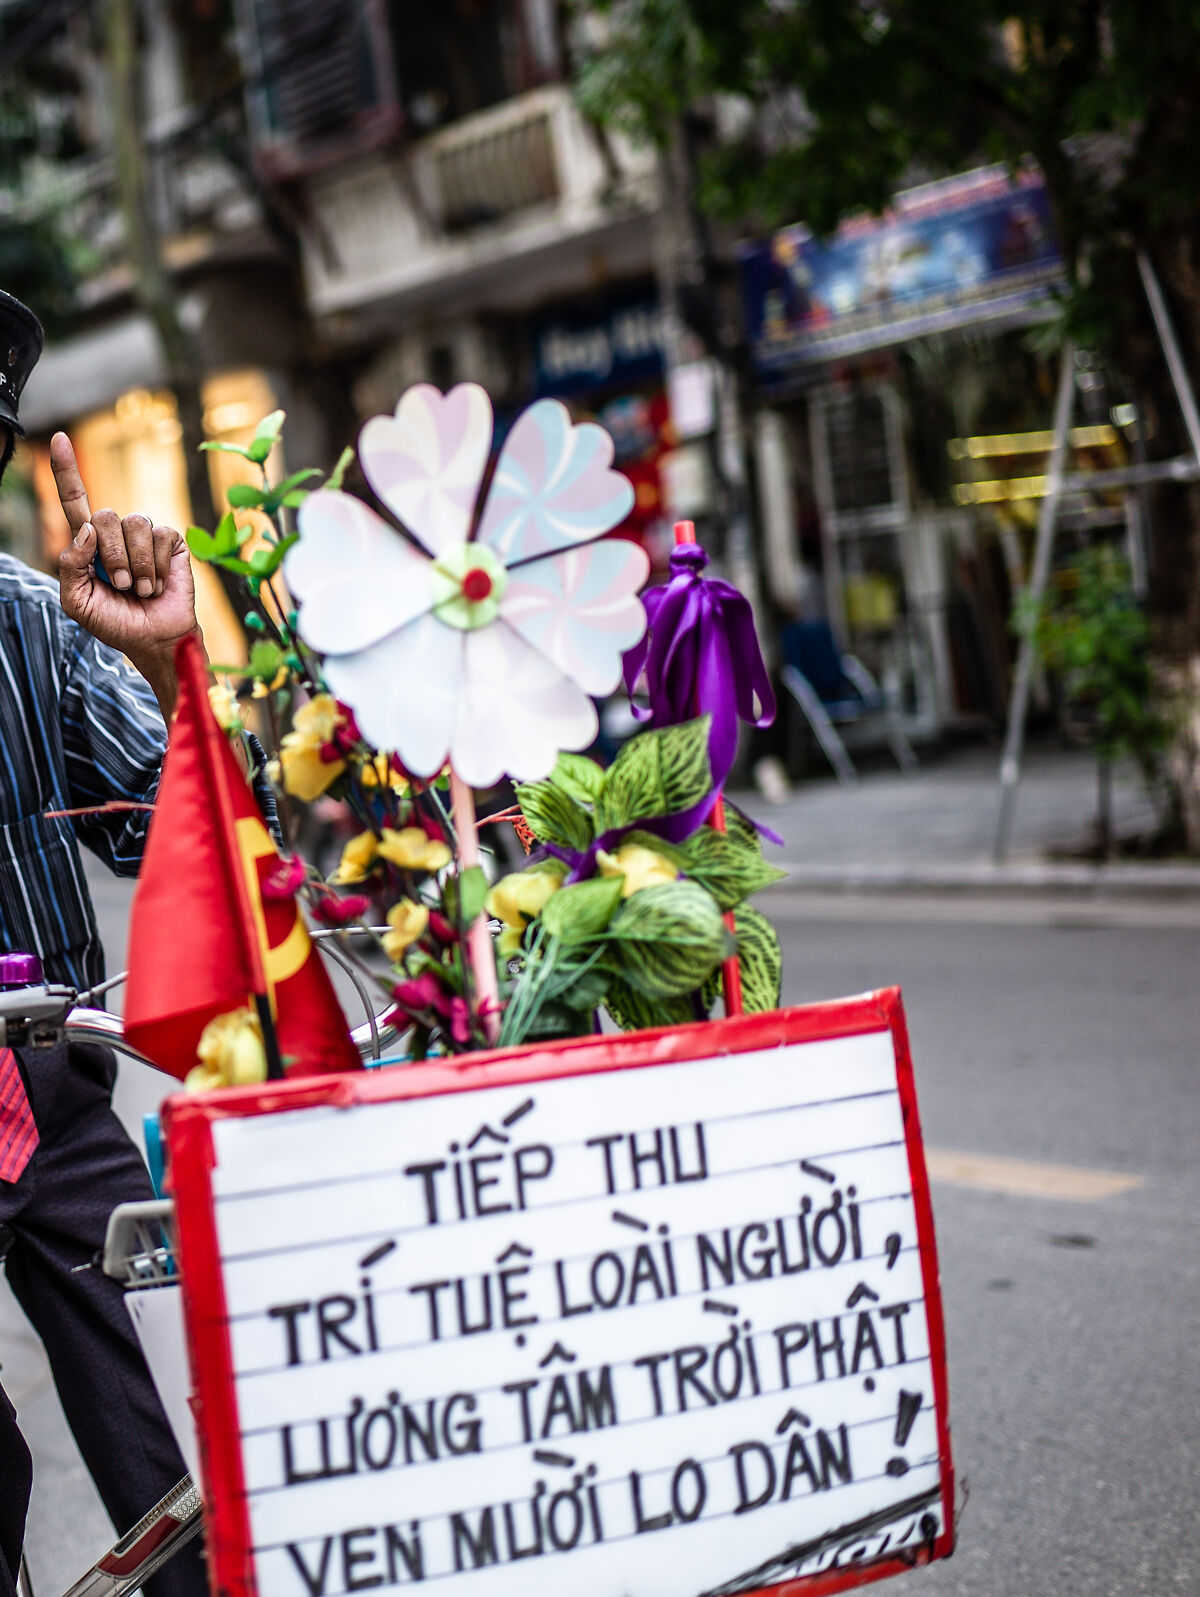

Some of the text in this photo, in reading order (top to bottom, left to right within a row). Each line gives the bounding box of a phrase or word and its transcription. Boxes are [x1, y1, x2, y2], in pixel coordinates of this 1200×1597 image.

[585, 1120, 709, 1196] THU
[407, 1241, 540, 1348] TUỆ
[281, 1388, 483, 1486] LƯƠNG
[501, 1339, 618, 1444] TÂM
[772, 1280, 912, 1393] PHẬT
[284, 1518, 425, 1597] VEN
[628, 1458, 708, 1534] LO
[728, 1406, 854, 1516] DÂN
